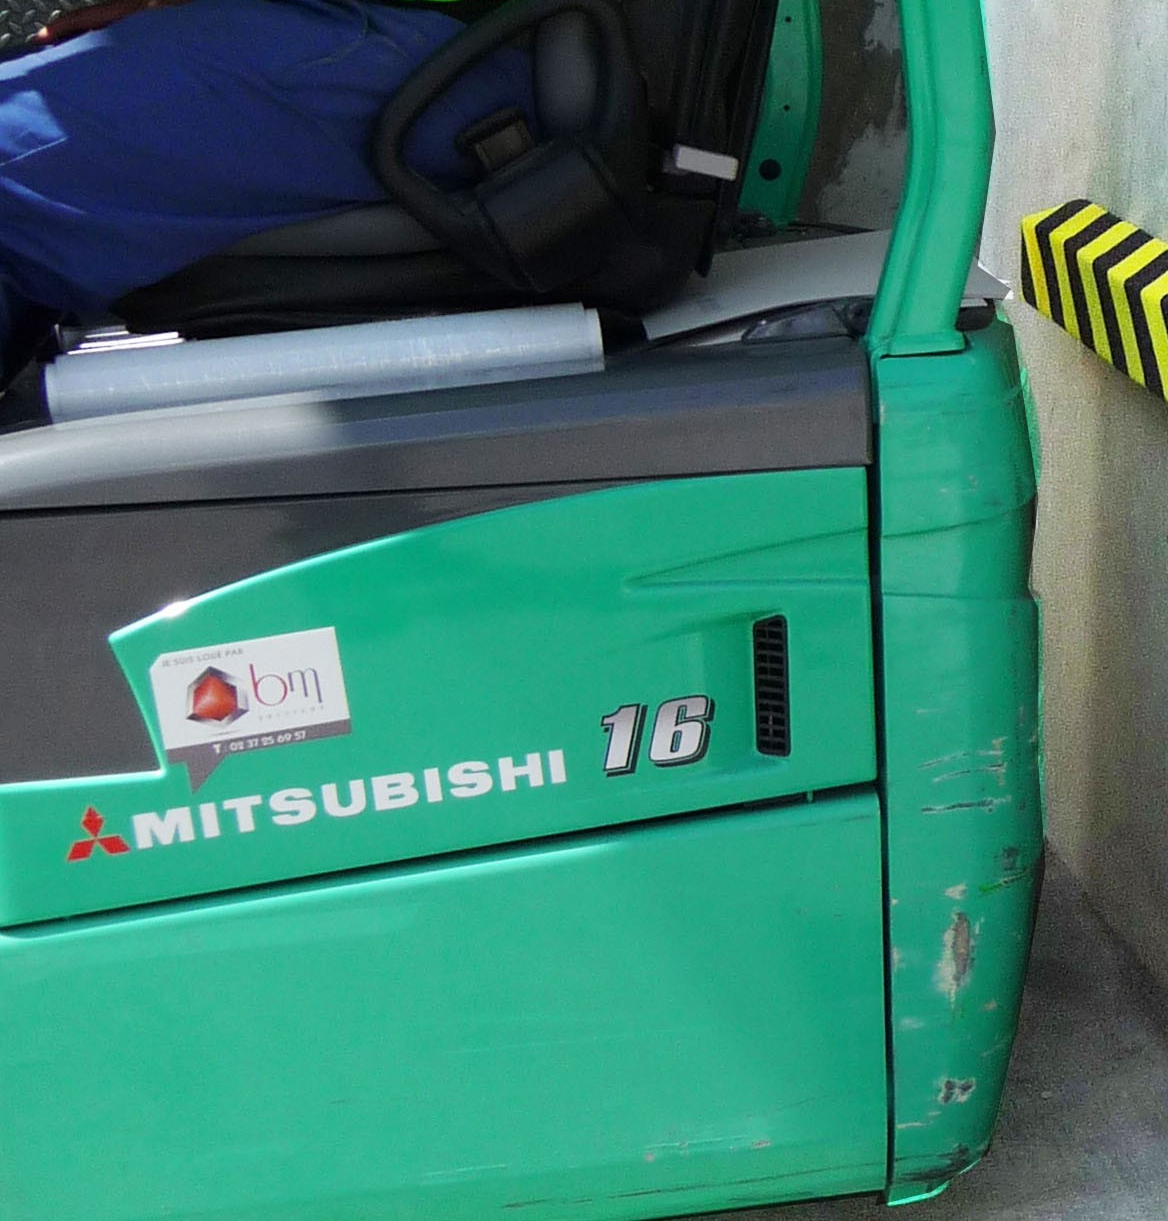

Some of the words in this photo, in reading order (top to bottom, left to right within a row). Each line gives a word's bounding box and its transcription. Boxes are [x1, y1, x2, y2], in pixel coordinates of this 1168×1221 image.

[229, 740, 244, 752] 02
[600, 694, 715, 777] 16
[132, 748, 567, 850] MITSUBISHI
